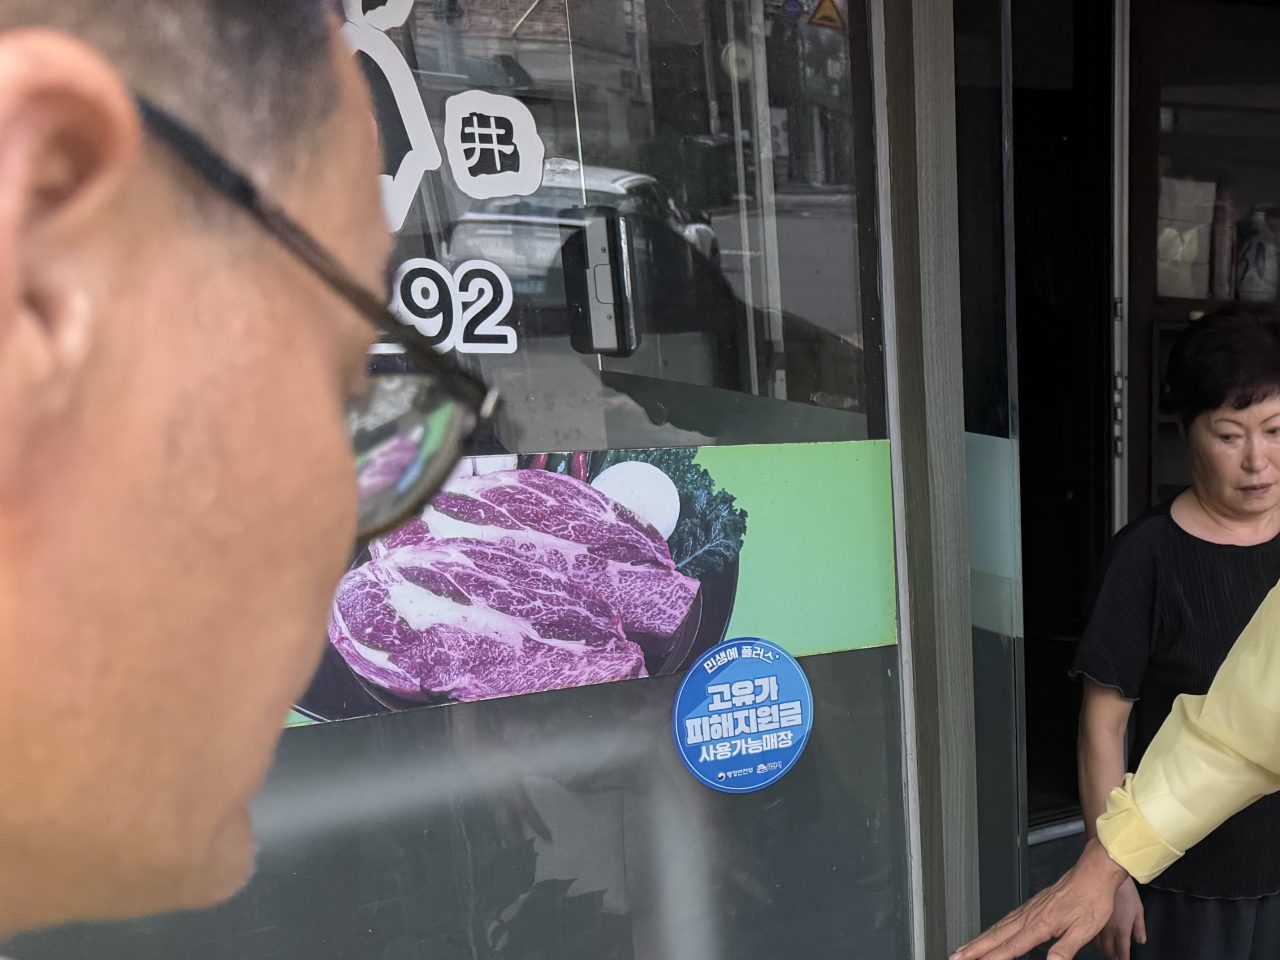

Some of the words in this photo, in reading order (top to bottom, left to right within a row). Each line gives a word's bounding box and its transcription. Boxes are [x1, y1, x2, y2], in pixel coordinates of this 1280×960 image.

[460, 112, 521, 177] 井
[703, 646, 739, 674] 민생에
[741, 645, 775, 664] 플러스
[707, 676, 779, 712] 고유가
[685, 700, 803, 745] 피해지원금
[699, 731, 794, 763] 사용가능매장
